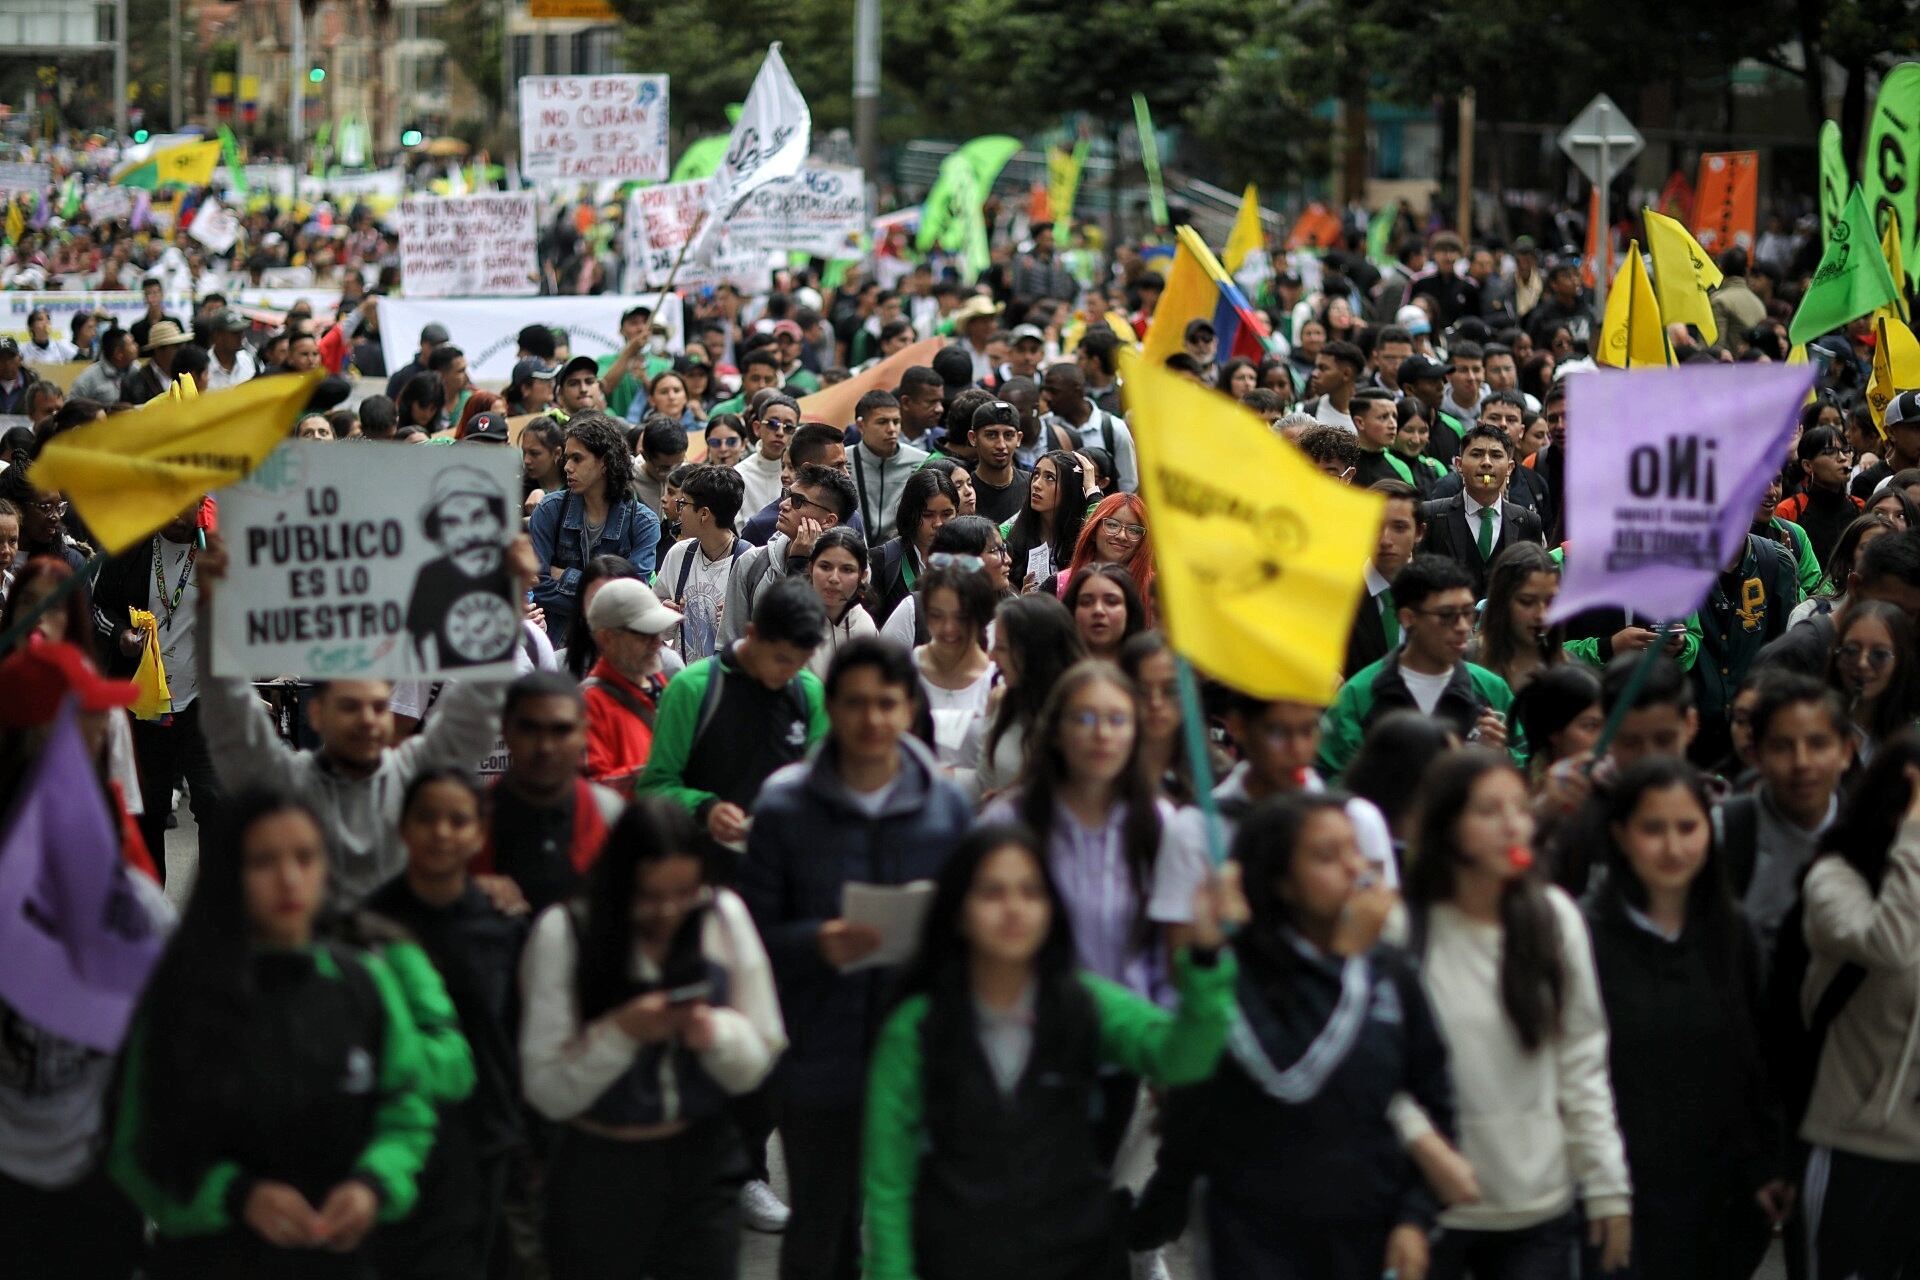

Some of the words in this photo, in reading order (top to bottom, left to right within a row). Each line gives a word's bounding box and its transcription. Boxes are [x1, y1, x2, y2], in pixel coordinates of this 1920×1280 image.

[537, 79, 582, 101] LAS
[589, 79, 635, 103] EPS
[540, 108, 569, 128] NO
[533, 132, 578, 152] LAS
[592, 132, 639, 152] EPS
[306, 486, 340, 517] LO
[245, 511, 403, 566] PÚBLICO
[290, 568, 324, 598] ES
[337, 567, 370, 595] LO
[246, 600, 402, 645] NUESTRO
